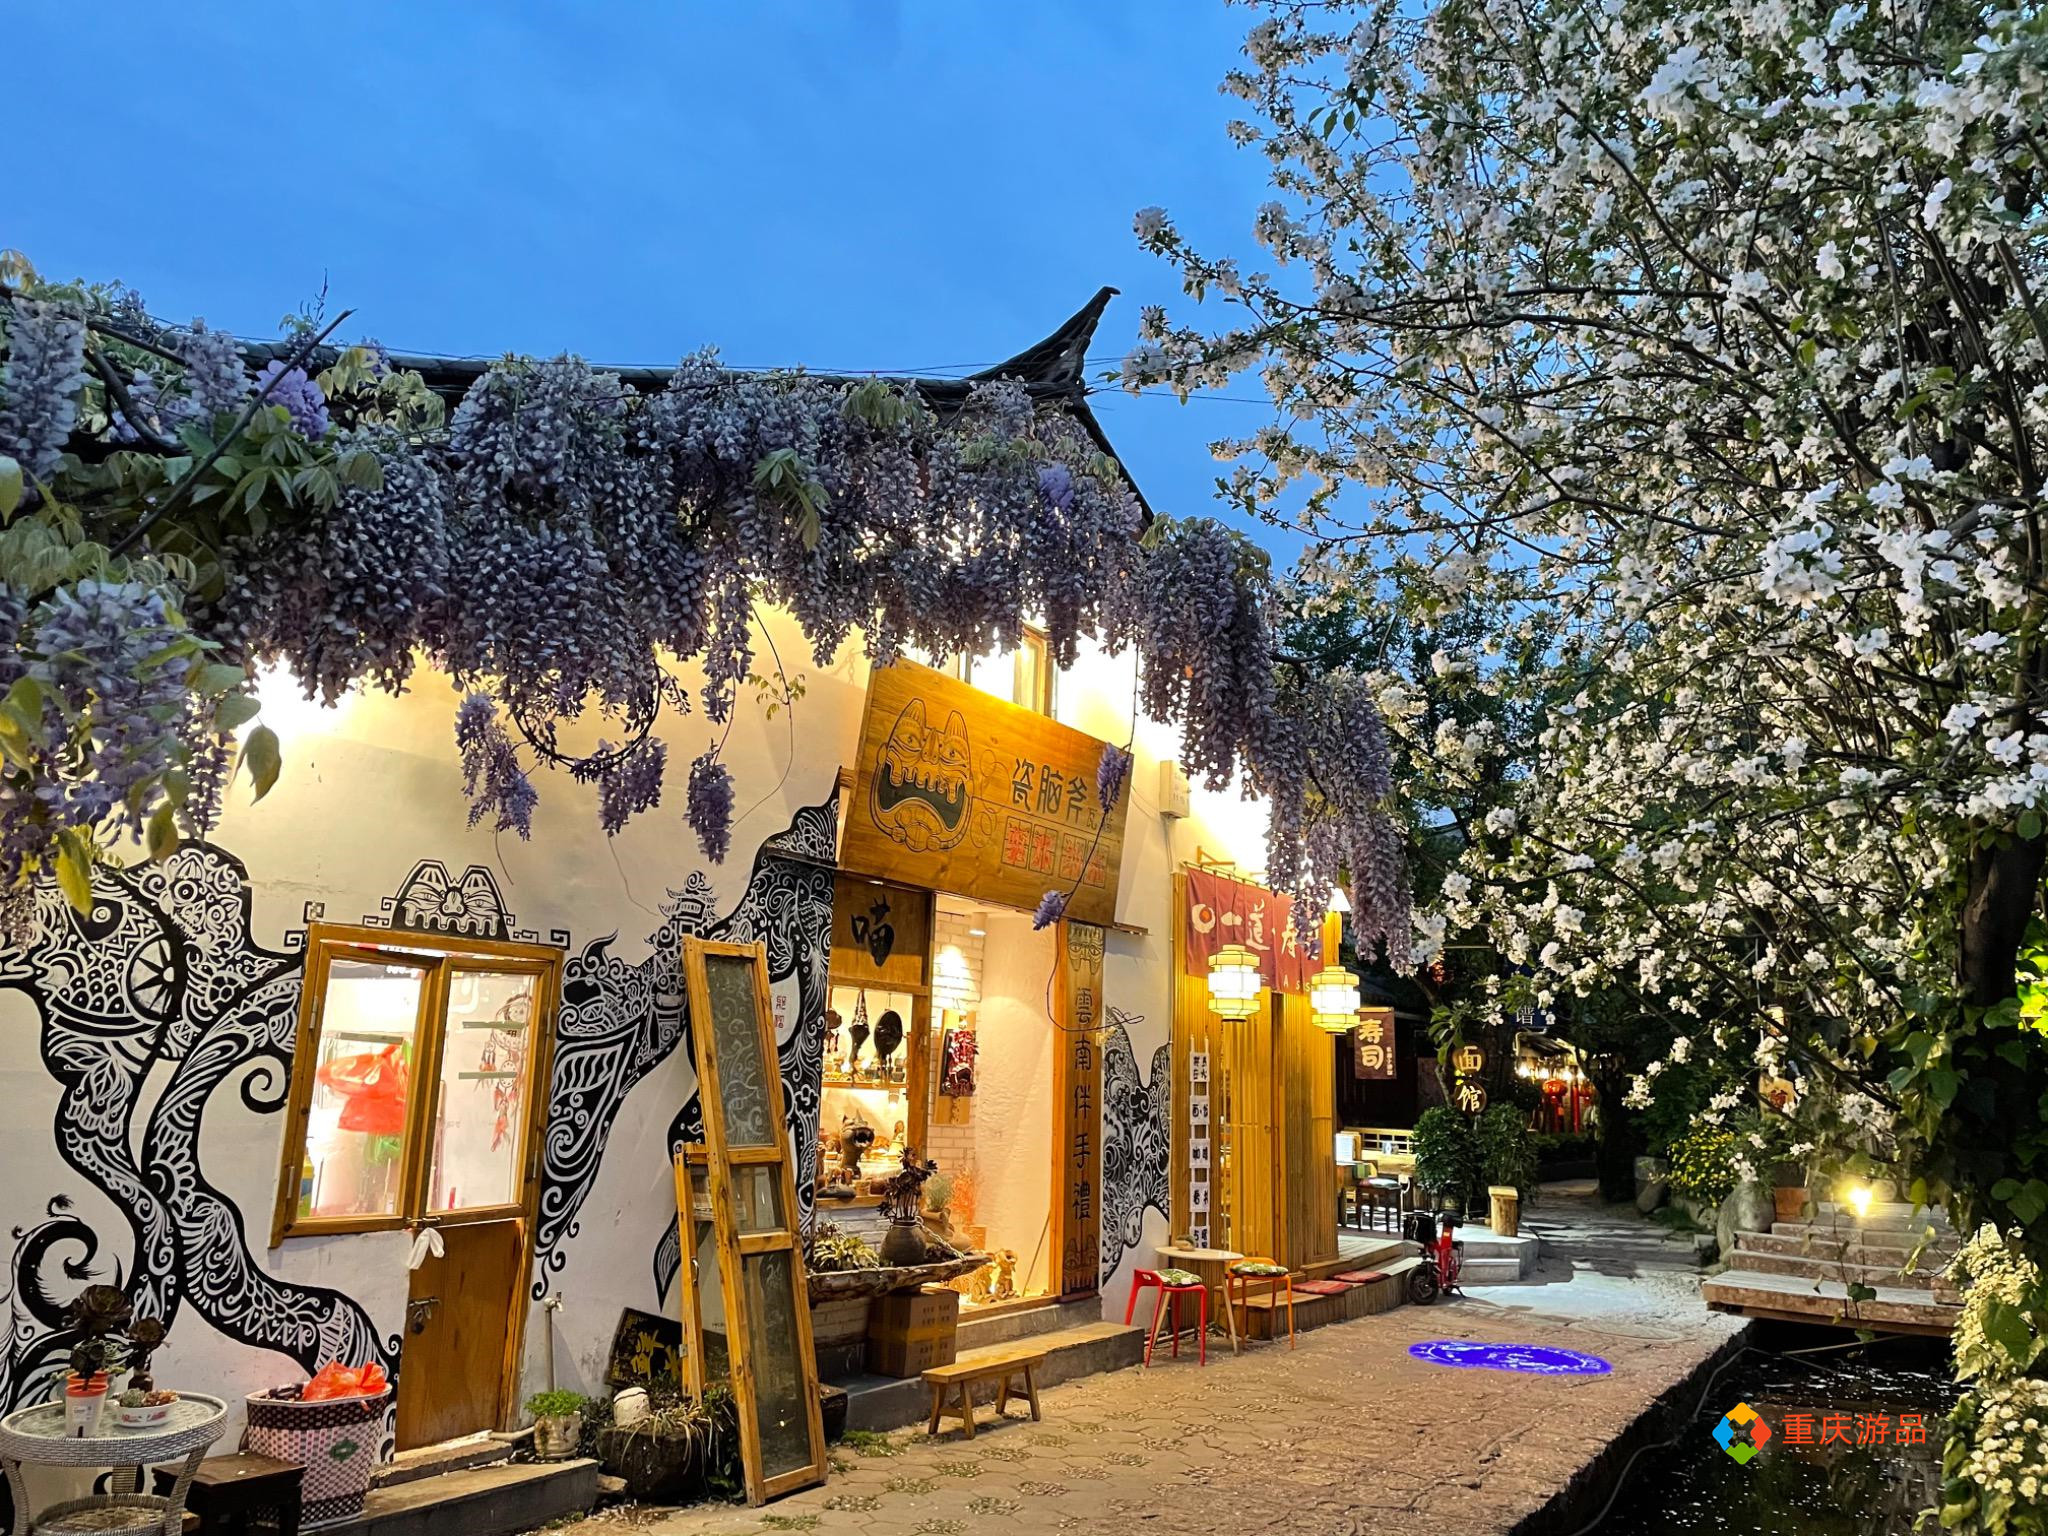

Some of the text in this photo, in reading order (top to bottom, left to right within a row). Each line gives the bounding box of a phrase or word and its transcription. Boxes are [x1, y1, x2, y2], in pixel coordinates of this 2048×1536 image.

[1012, 757, 1088, 824] 瓷脑斧
[851, 893, 894, 967] 喵
[1358, 1019, 1384, 1070] 寿司
[1457, 1045, 1482, 1112] 面馆
